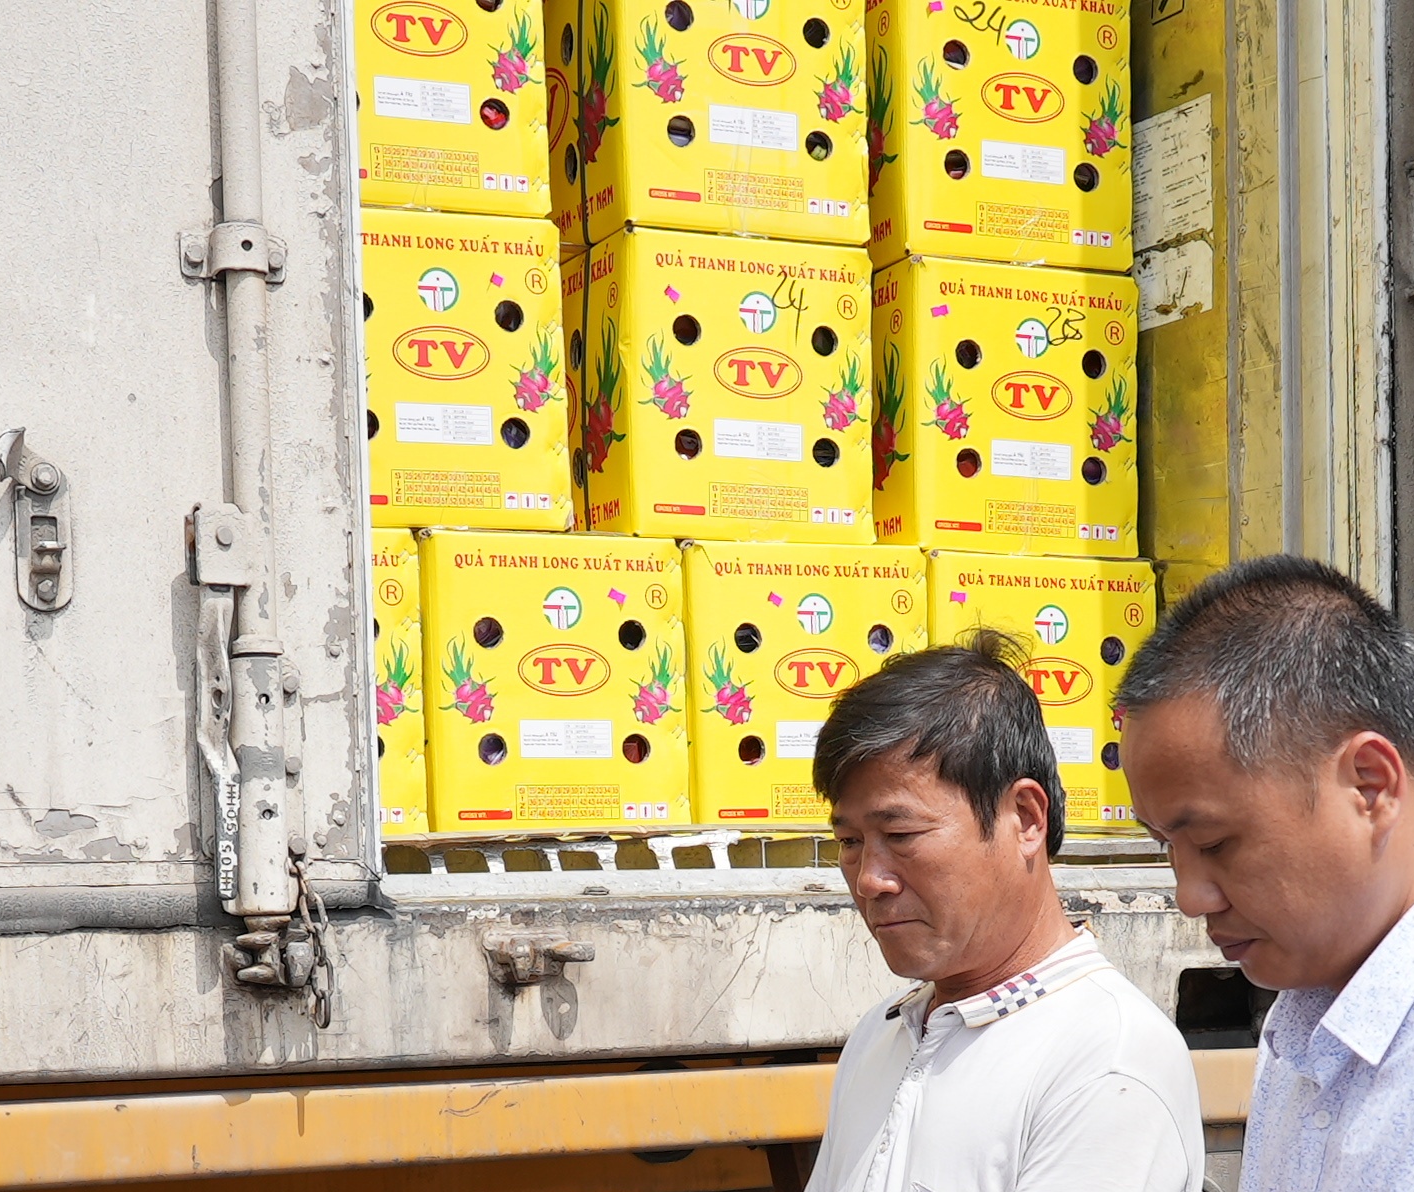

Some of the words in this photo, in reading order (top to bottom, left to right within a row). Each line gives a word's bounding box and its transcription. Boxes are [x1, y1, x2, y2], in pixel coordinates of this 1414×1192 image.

[386, 11, 454, 48] TV
[953, 1, 1007, 46] 24
[720, 42, 784, 78] TV
[993, 81, 1054, 115] TV
[417, 236, 455, 251] LONG
[460, 234, 500, 254] XUẤT
[505, 236, 544, 257] KHẨU
[656, 249, 683, 268] QUẢ
[690, 256, 736, 272] THANH
[741, 261, 774, 275] LONG
[780, 262, 816, 282] XUẤT
[821, 264, 855, 285] KHẨU
[940, 278, 966, 296] QUẢ
[971, 284, 1013, 300] THANH
[1017, 289, 1048, 303] LONG
[1053, 289, 1086, 307] XUẤT
[1089, 291, 1123, 312] KHẨU
[407, 338, 475, 371] TV
[727, 358, 790, 390] TV
[1003, 381, 1061, 412] TV
[455, 549, 484, 569] QUẢ
[490, 554, 538, 568] THANH
[544, 557, 579, 569] LONG
[584, 553, 622, 571] XUẤT
[627, 553, 664, 573] KHẨU
[715, 562, 742, 577] QUẢ
[748, 563, 792, 576] THANH
[797, 564, 830, 577] LONG
[835, 560, 870, 578] XUẤT
[874, 559, 908, 579] KHẨU
[959, 571, 984, 587] QUẢ
[990, 574, 1031, 588] THANH
[1035, 577, 1067, 589] LONG
[1071, 575, 1105, 591] XUẤT
[1108, 572, 1141, 593] KHẨU
[533, 657, 597, 685] TV
[788, 661, 849, 691] TV
[1027, 668, 1081, 699] TV
